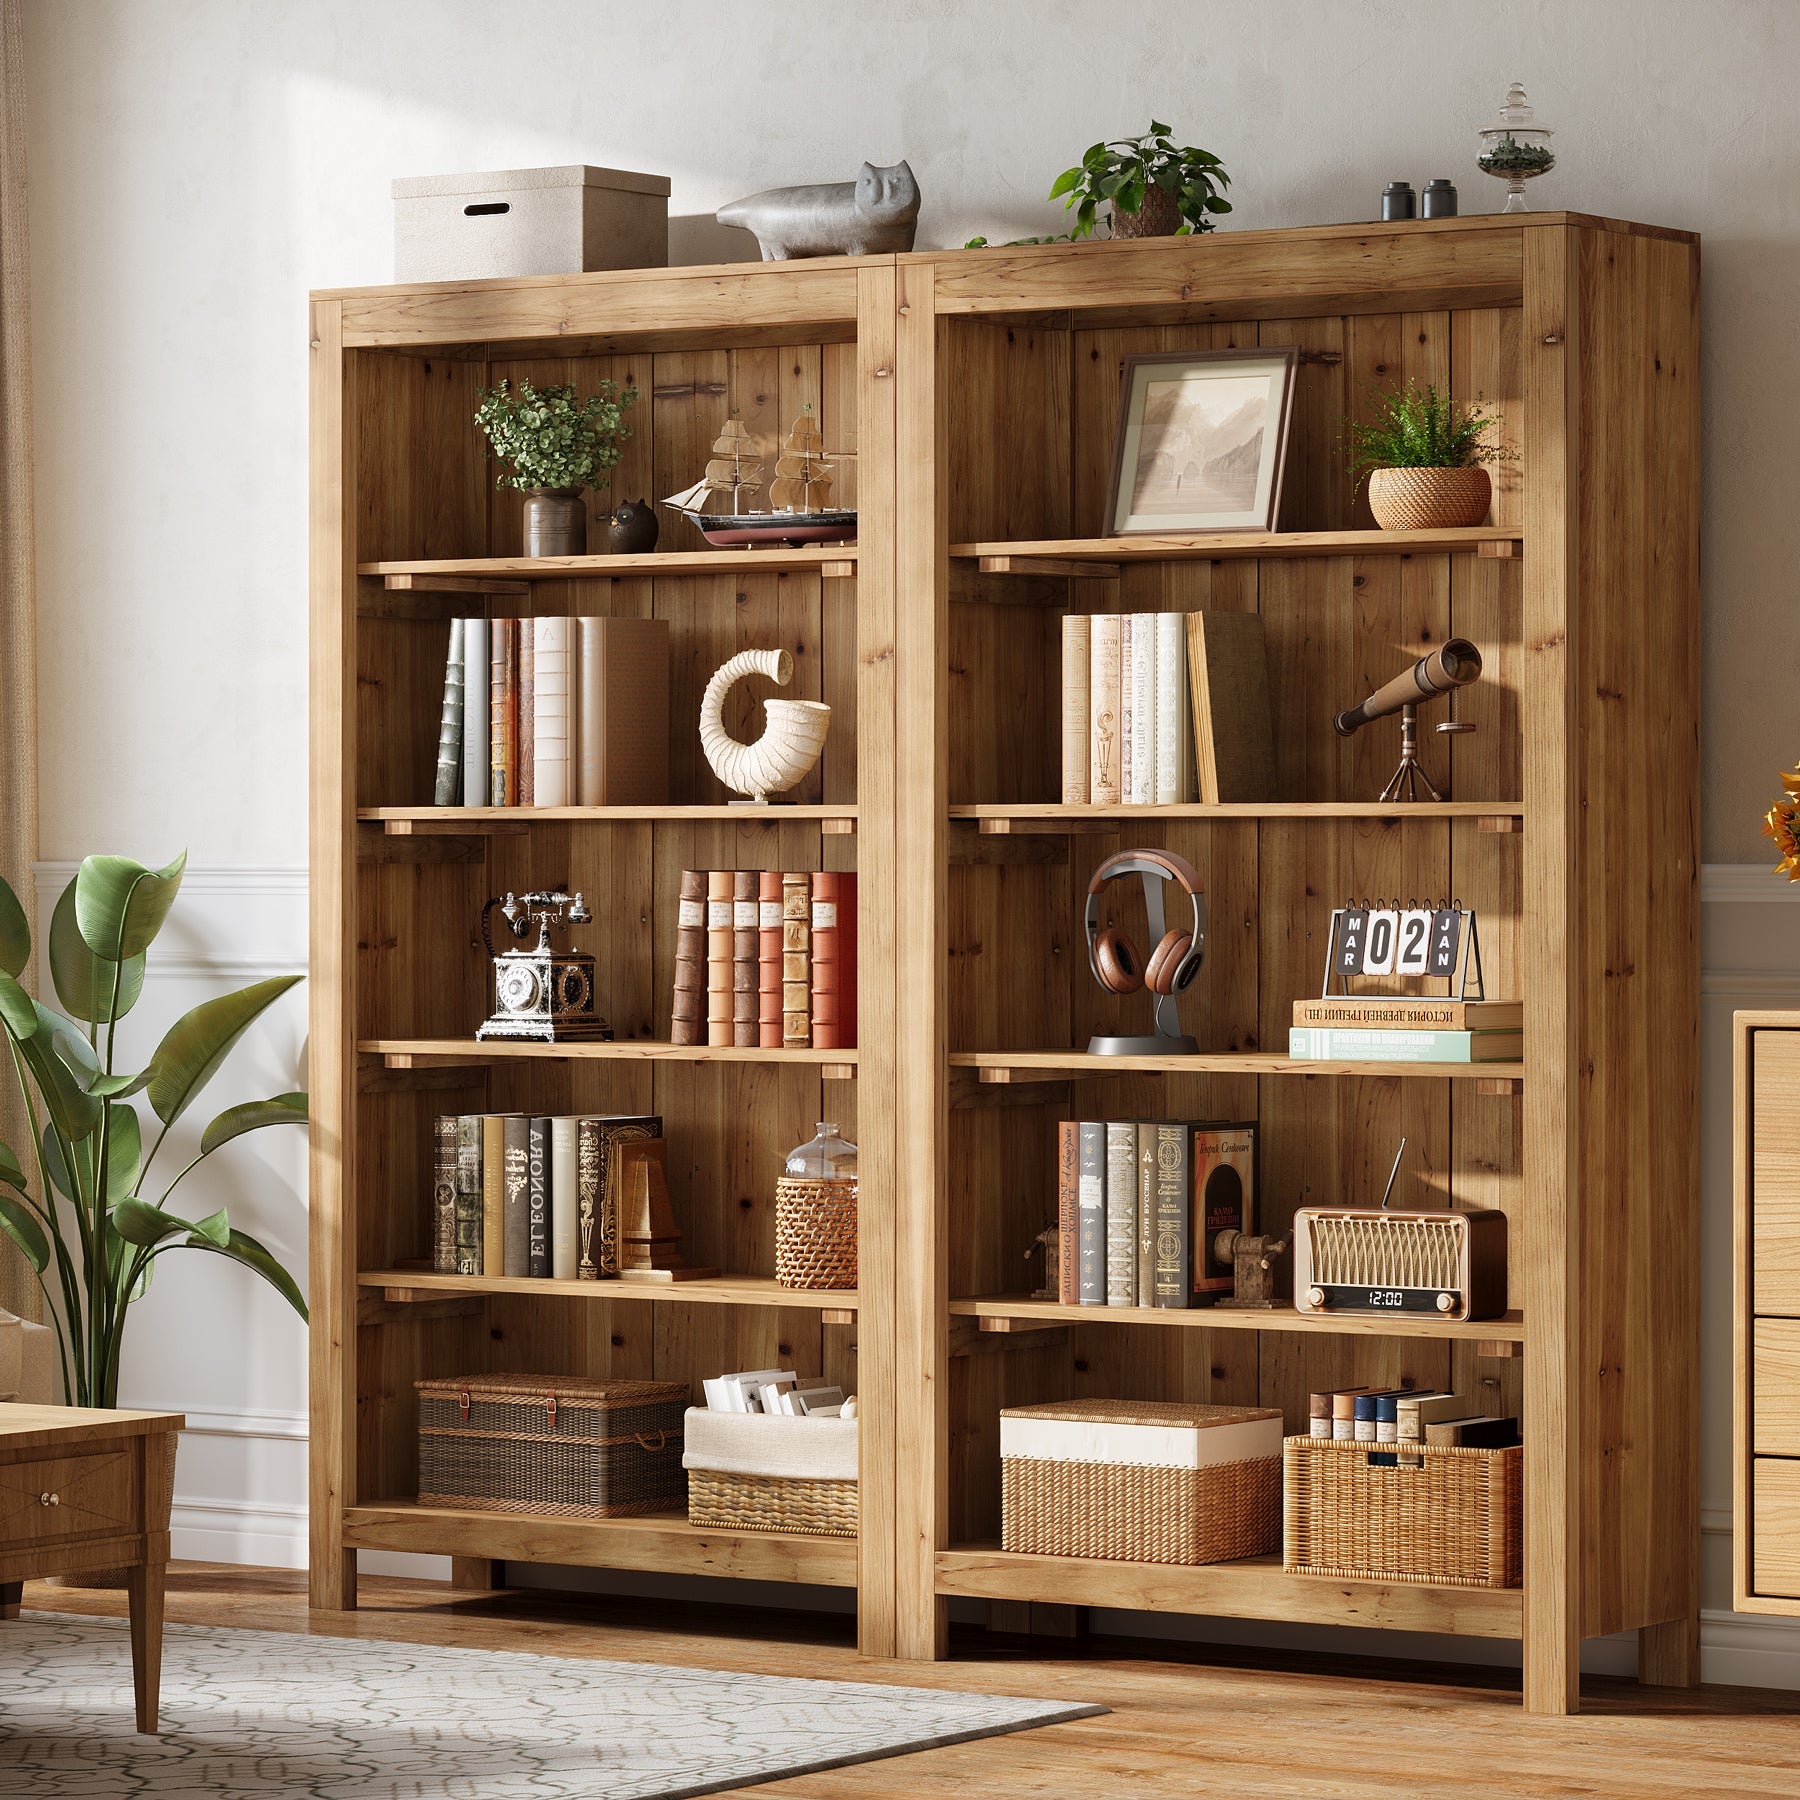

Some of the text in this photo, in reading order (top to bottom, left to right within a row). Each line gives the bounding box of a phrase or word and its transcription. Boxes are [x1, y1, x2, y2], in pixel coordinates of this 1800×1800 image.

[1344, 917, 1361, 966] MAR
[1438, 917, 1450, 966] JAN
[1325, 1008, 1361, 1021] ГРЕЦИИ
[1363, 1009, 1406, 1023] ДРЕВНЕЙ
[1408, 1010, 1453, 1023] ИСТОРИЯ
[1064, 1244, 1072, 1297] ЗАПИСКИ
[1369, 1291, 1402, 1306] 12:00
